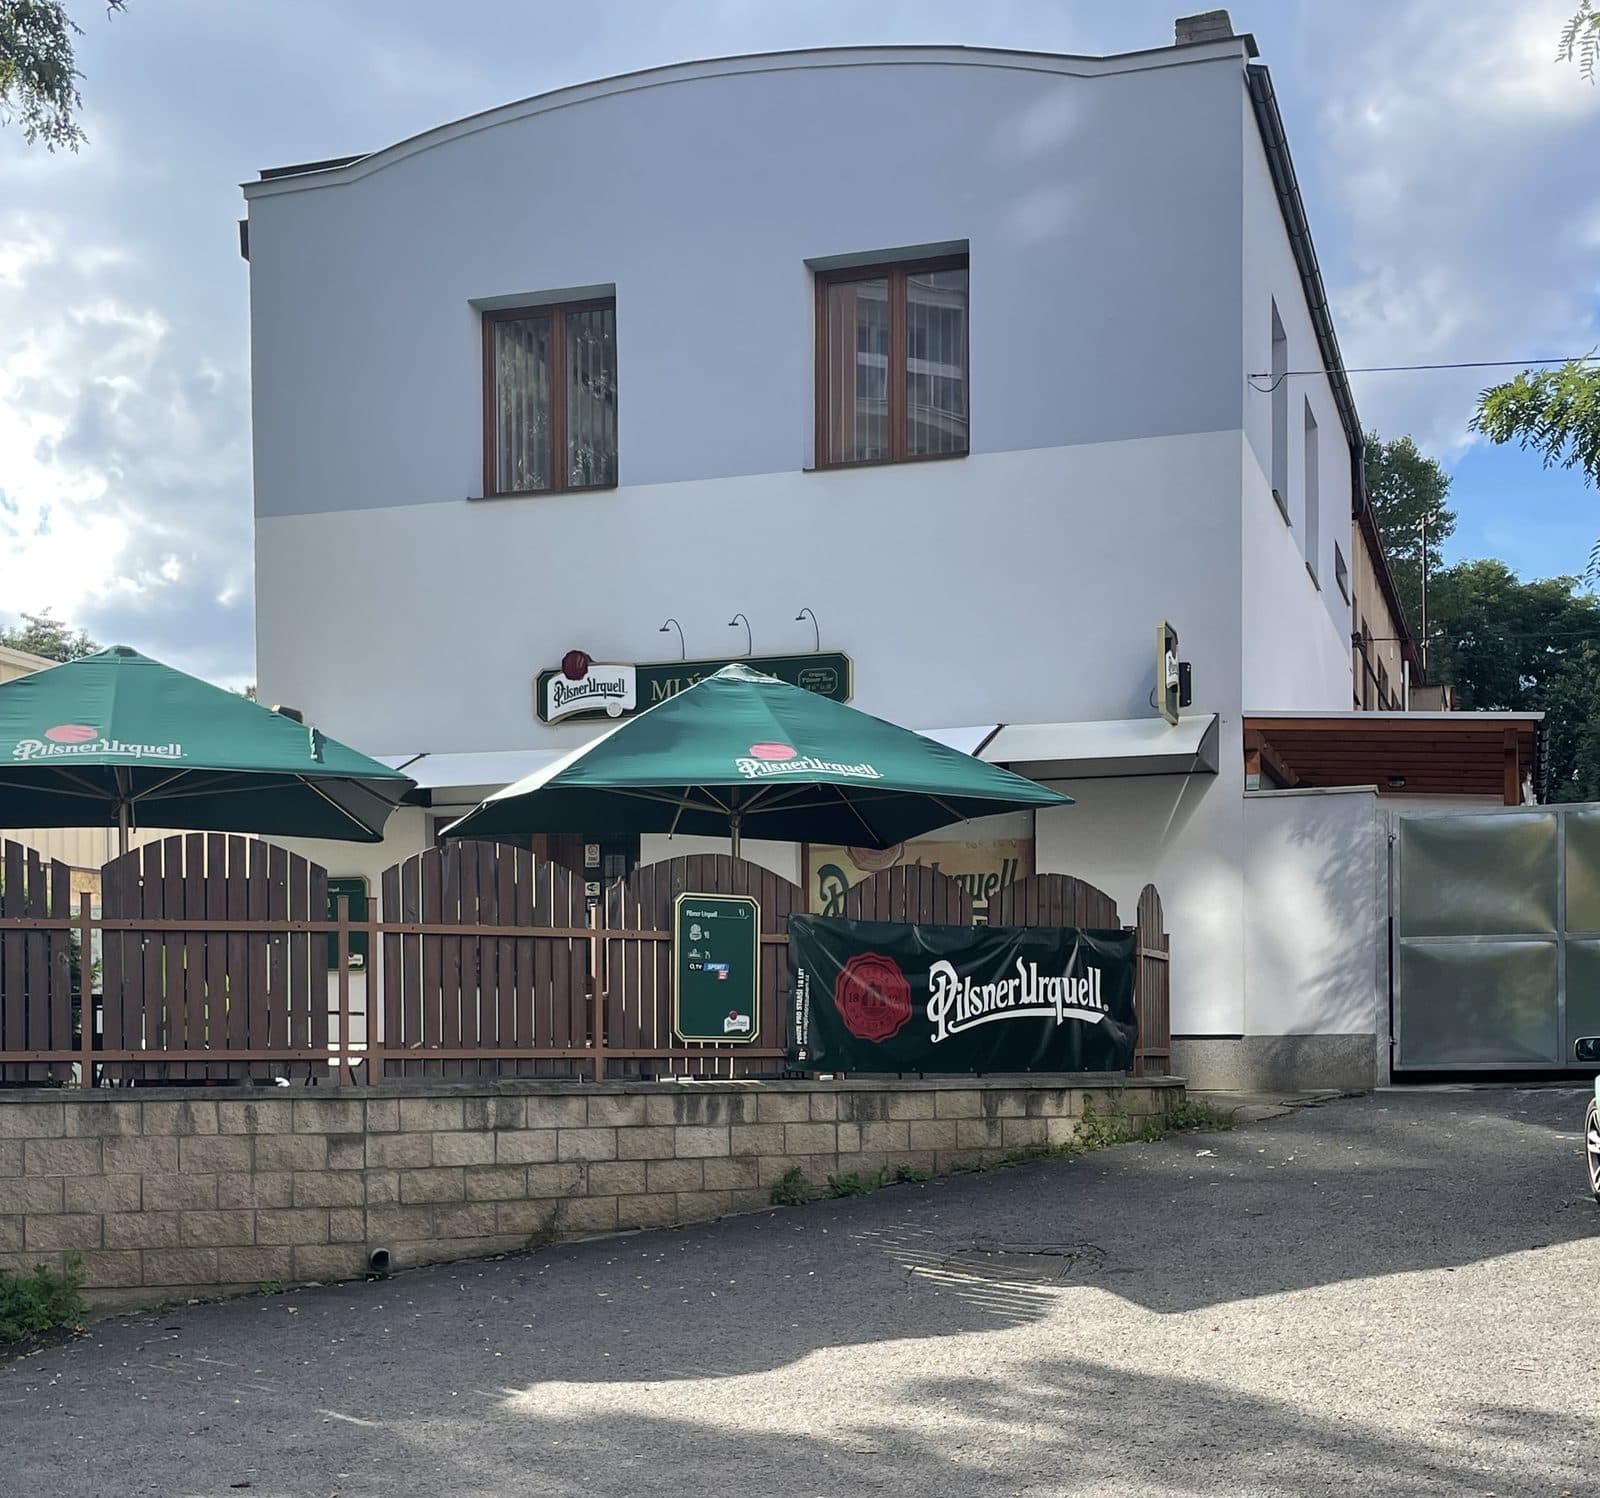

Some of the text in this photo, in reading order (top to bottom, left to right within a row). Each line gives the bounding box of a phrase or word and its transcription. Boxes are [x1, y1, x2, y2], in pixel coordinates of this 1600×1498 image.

[553, 677, 625, 709] Pilsner Urquell
[12, 738, 183, 761] Pilsner Urquell
[735, 755, 880, 779] Pilsner Urquell
[926, 956, 1103, 1043] Pilsner Urquell
